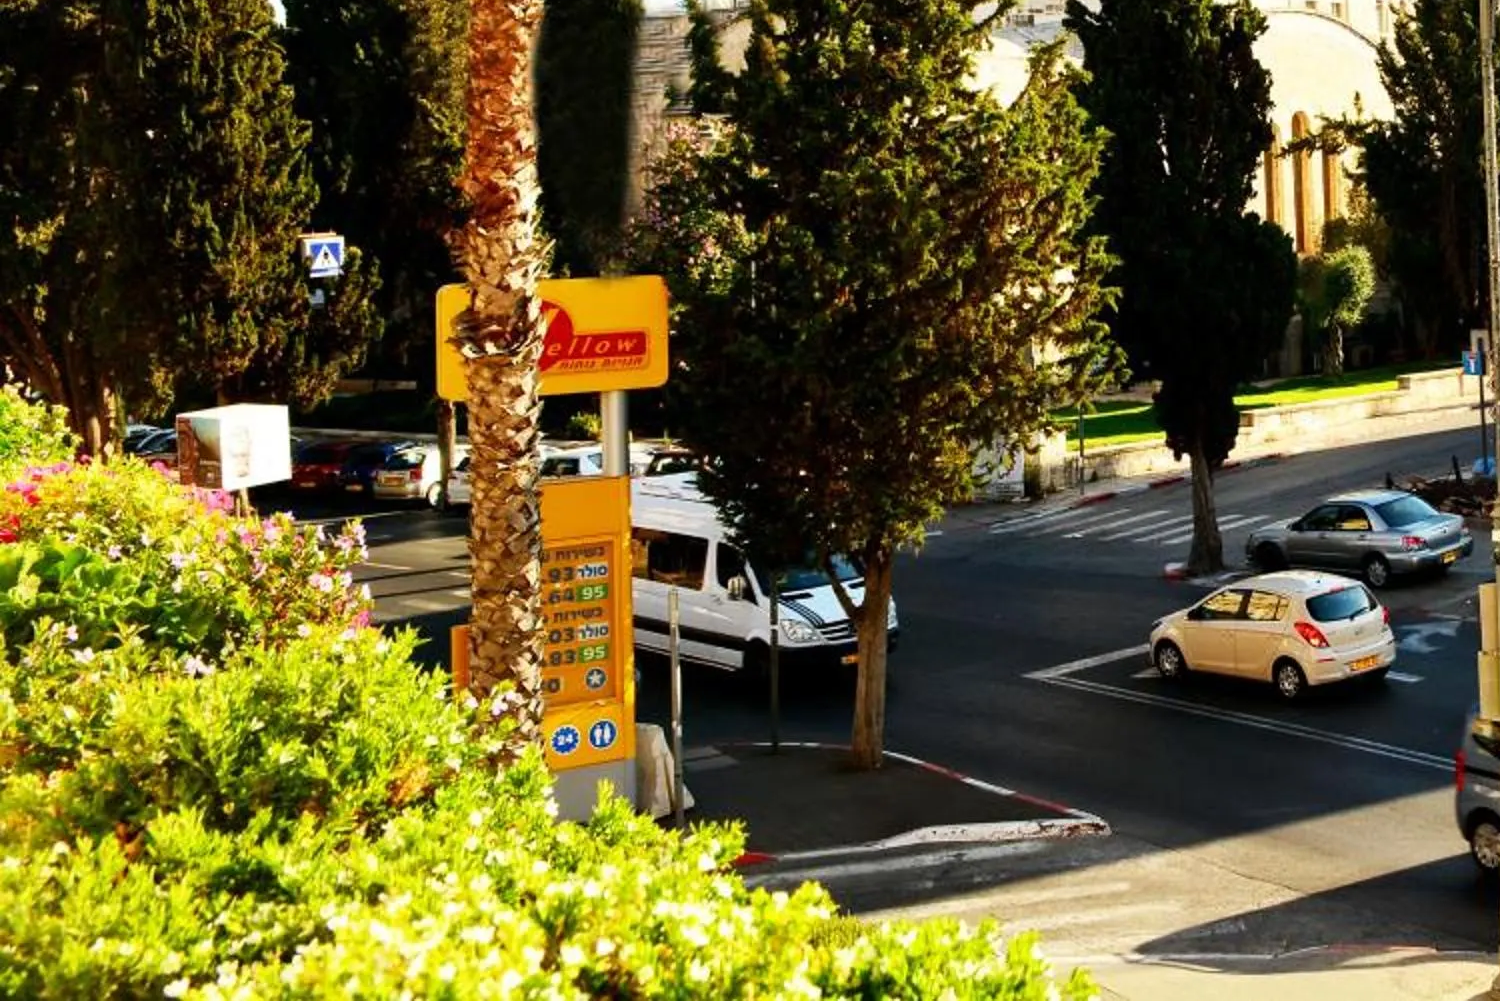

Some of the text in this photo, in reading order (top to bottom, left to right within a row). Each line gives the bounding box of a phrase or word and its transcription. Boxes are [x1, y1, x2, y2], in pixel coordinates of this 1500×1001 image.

[546, 336, 638, 357] ellow
[581, 585, 606, 600] 95
[583, 645, 606, 661] 95
